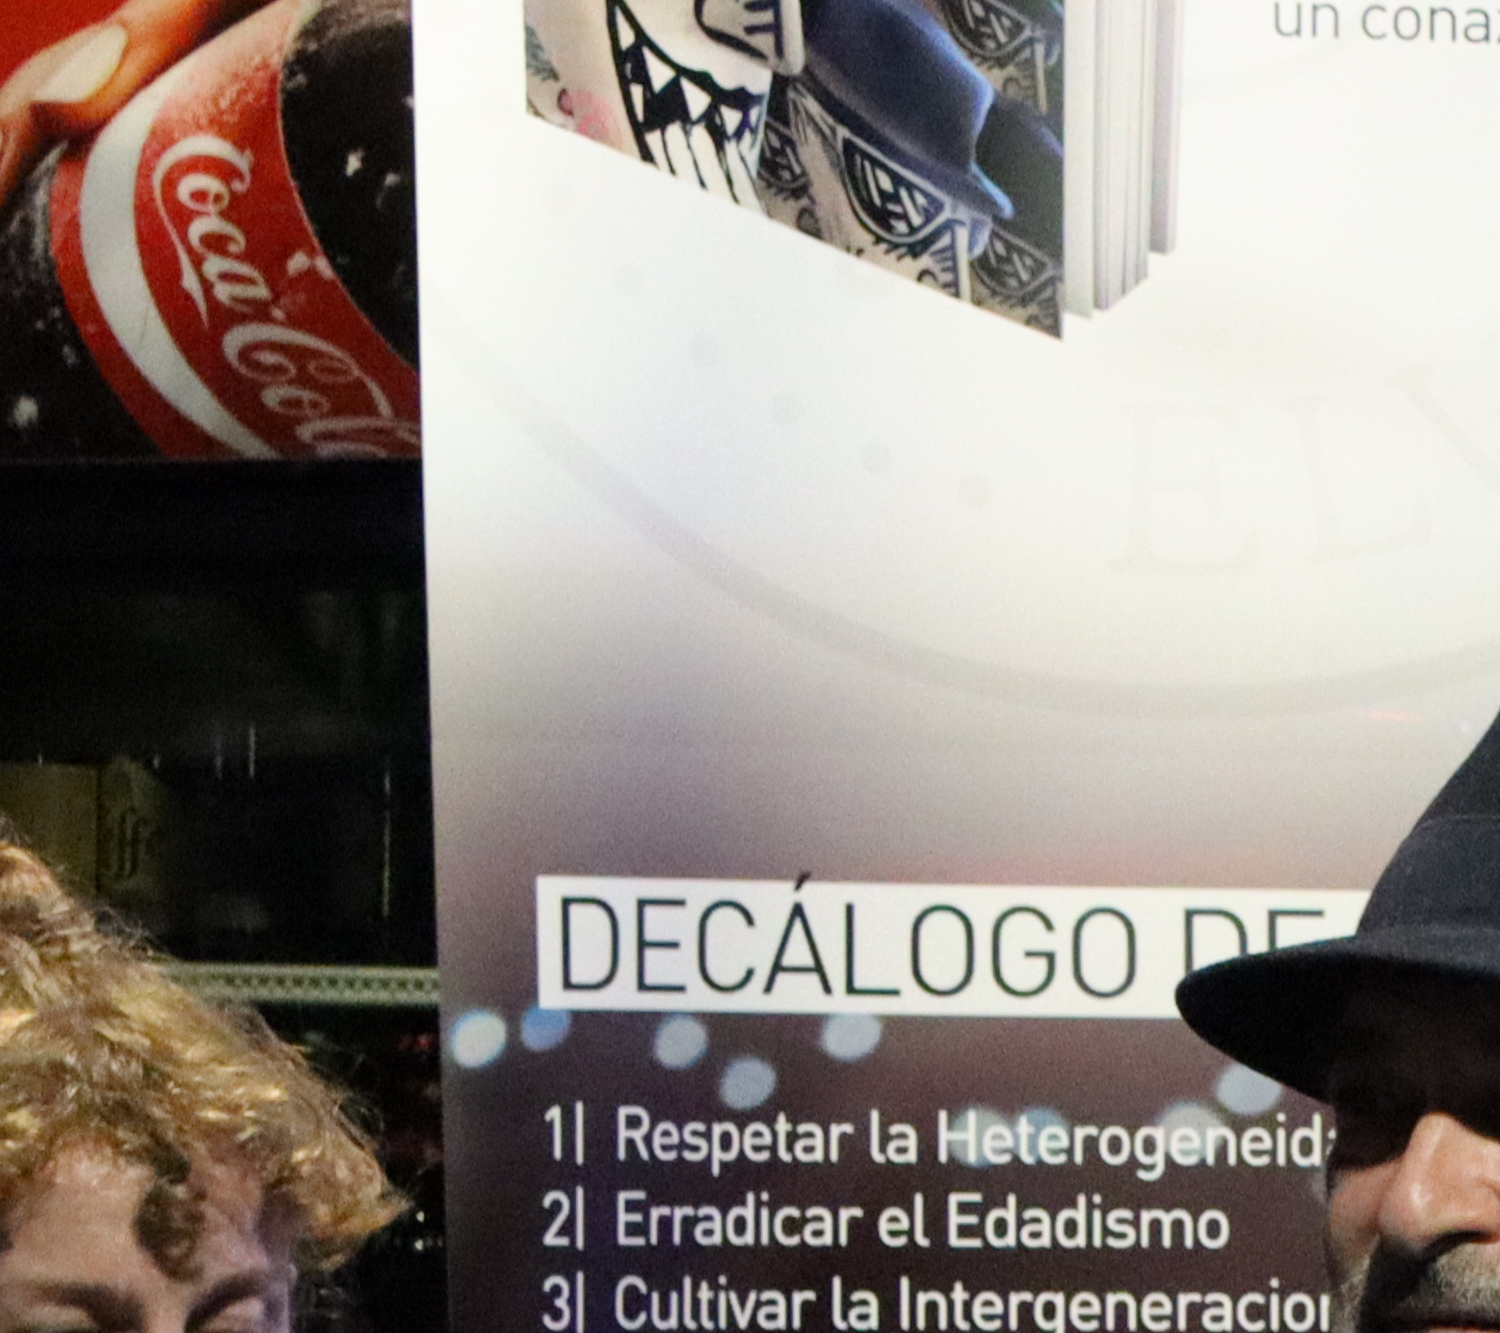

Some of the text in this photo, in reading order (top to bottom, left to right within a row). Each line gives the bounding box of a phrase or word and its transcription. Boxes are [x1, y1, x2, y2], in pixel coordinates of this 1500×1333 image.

[1273, 0, 1340, 39] un
[560, 872, 1137, 997] DECÁLOGO
[617, 1105, 855, 1177] Respetar
[870, 1108, 918, 1164] la
[937, 1104, 1335, 1182] Heterogeneid
[616, 1190, 864, 1247] Erradicar
[877, 1192, 931, 1248] el
[947, 1192, 1230, 1250] Edadismo
[615, 1274, 817, 1331] Cultivar
[832, 1275, 880, 1331] la
